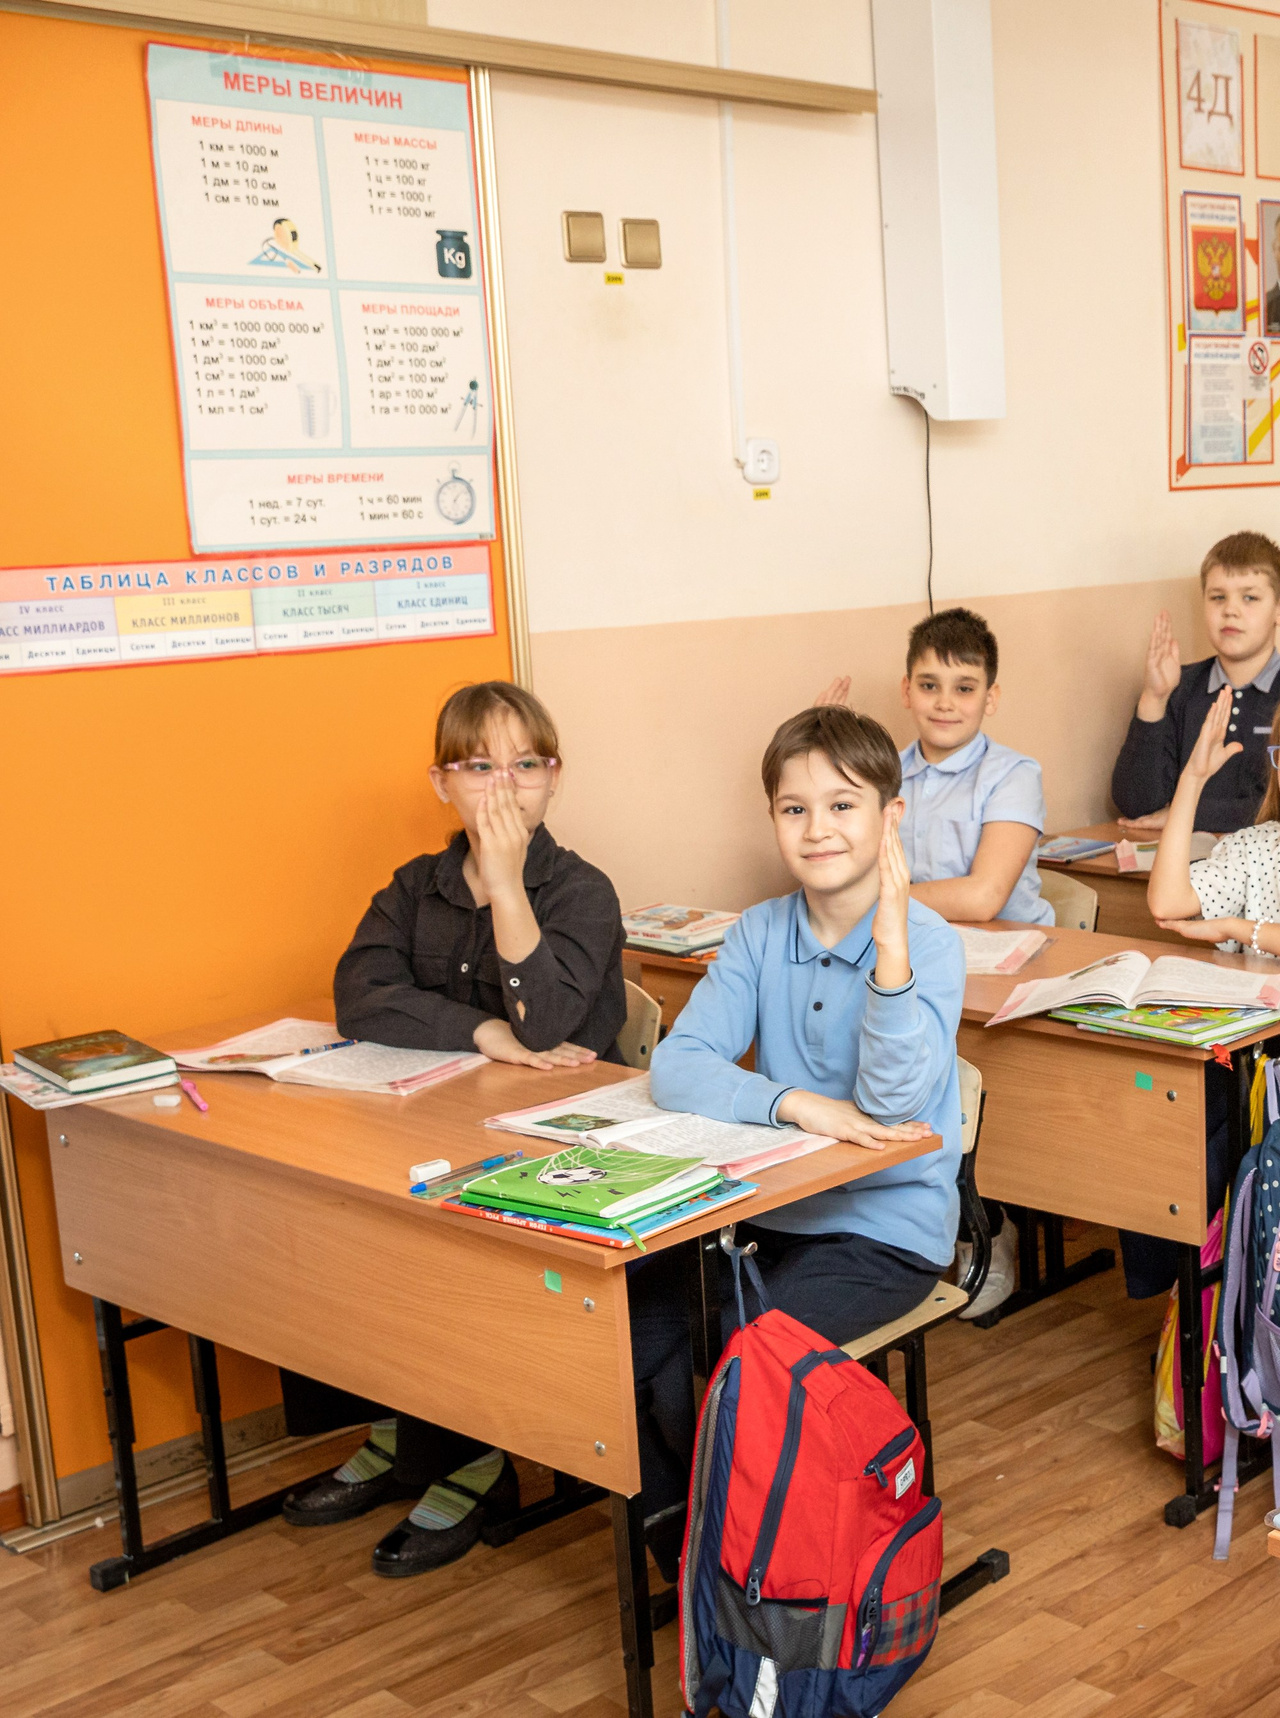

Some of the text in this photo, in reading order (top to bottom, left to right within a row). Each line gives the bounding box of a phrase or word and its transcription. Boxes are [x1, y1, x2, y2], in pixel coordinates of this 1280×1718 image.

[223, 71, 403, 110] МЕРЫ ВЕЛИЧИН
[1187, 70, 1234, 127] 4Д
[191, 115, 283, 135] МЕРЫ ДЛИНЫ
[354, 132, 437, 150] МЕРЫ МАССЫ
[210, 144, 224, 152] км
[240, 144, 266, 156] 1000
[270, 149, 279, 157] м
[236, 160, 249, 172] 10
[252, 164, 268, 173] дм
[393, 158, 418, 170] 1000
[213, 178, 229, 187] дм
[245, 178, 258, 189] 10
[261, 181, 277, 190] см
[396, 175, 414, 185] 100
[417, 178, 426, 186] кг
[215, 195, 230, 204] см
[246, 195, 259, 206] 10
[262, 199, 279, 207] мм
[377, 191, 386, 199] кг
[401, 191, 425, 202] 1000
[397, 206, 421, 218] 1000
[444, 247, 466, 268] Kg
[205, 297, 245, 309] МЕРЫ
[361, 304, 460, 317] МЕРЫ ПЛОЩАДИ
[234, 321, 261, 332] 1000
[264, 322, 285, 333] 000
[289, 323, 309, 334] 000
[404, 327, 428, 337] 1000
[431, 327, 450, 337] 000
[230, 338, 257, 349] 1000
[380, 406, 390, 414] га
[405, 405, 416, 414] 10
[420, 404, 437, 414] 000
[287, 473, 384, 484] МЕРЫ ВРЕМЕНИ
[386, 494, 399, 505] 60
[402, 496, 422, 504] мин
[369, 512, 389, 521] мин
[402, 509, 414, 519] 60
[46, 556, 453, 592] ТАБЛИЦА КЛАССОВ И РАЗРЯДОВ
[397, 596, 468, 609] КЛАСС ЕДИНИЦ
[282, 605, 350, 618] КЛАСС ТЫСЯЧ
[132, 612, 240, 628] КЛАСС МИЛЛИОНОВ
[0, 621, 105, 637] АСС МИЛЛИАРДОВ
